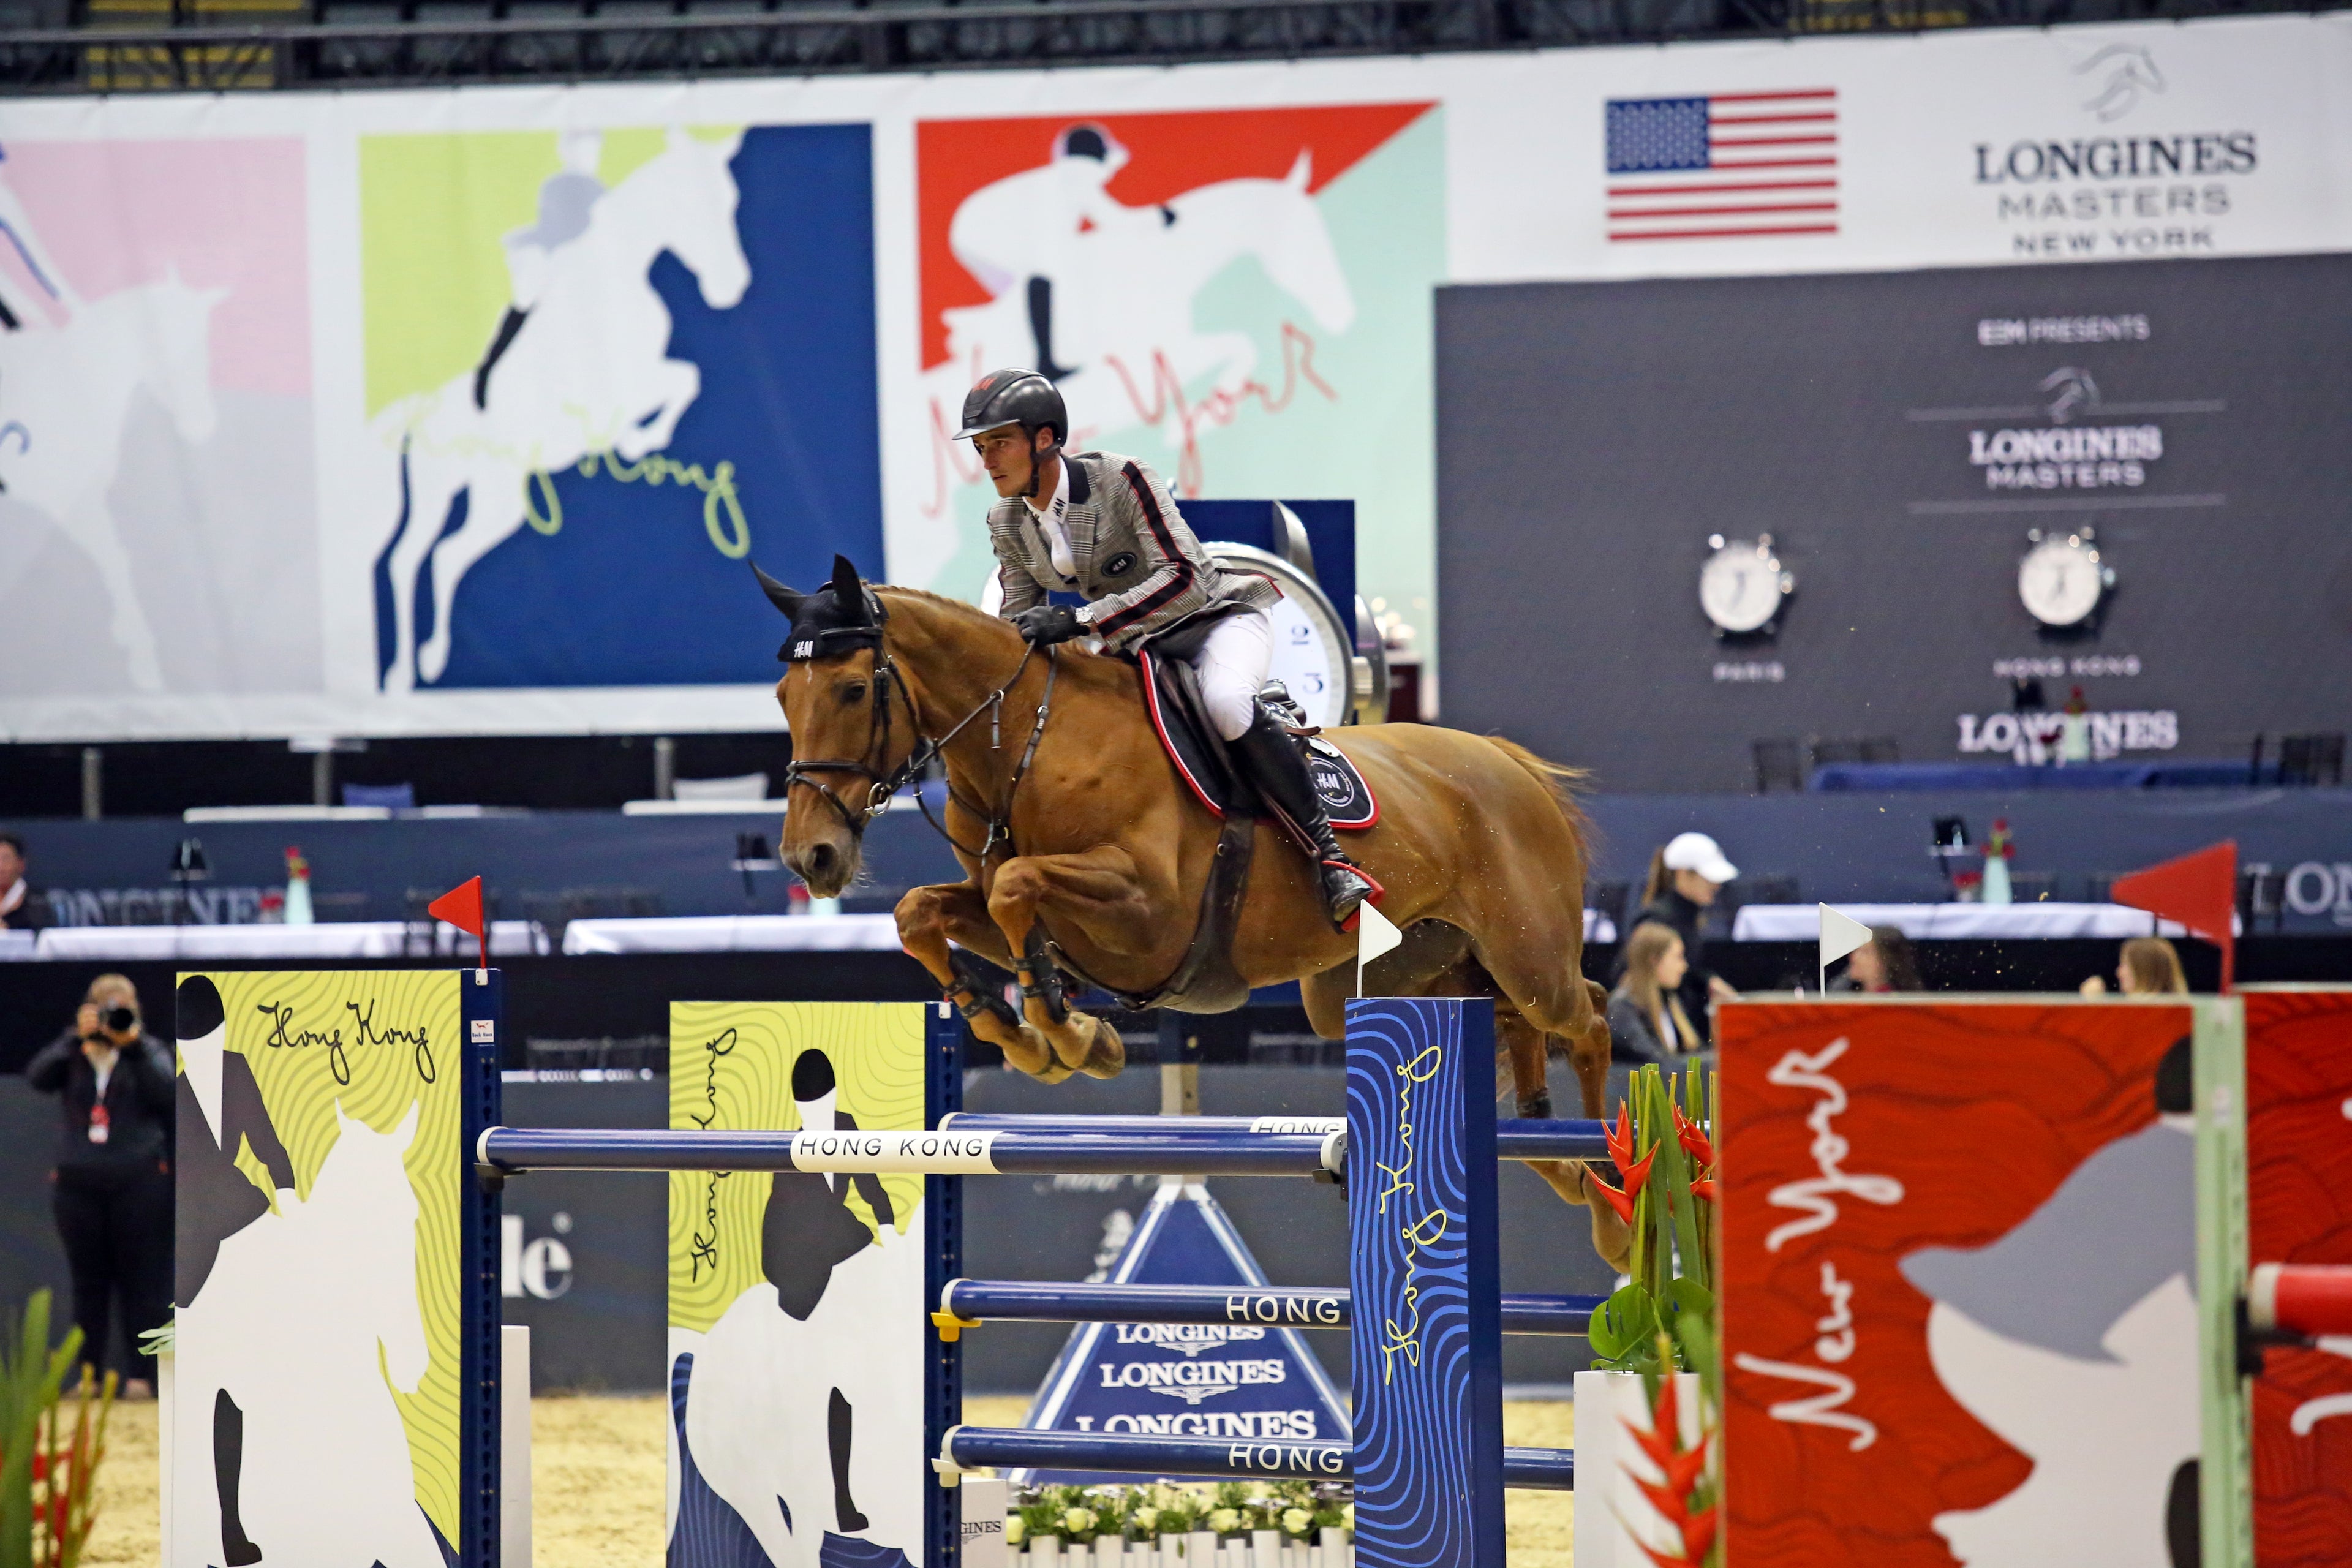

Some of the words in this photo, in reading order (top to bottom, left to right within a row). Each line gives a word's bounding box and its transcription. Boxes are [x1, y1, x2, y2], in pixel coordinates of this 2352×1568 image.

[1972, 131, 2258, 184] LONGINES
[1998, 185, 2231, 222] MASTERS
[2013, 232, 2097, 255] NEW
[2111, 227, 2214, 253] YORK
[1968, 425, 2163, 465] LONGINES
[1986, 461, 2145, 489] MASTERS
[257, 1001, 350, 1085] Hong
[347, 998, 435, 1084] Kong
[1376, 1045, 1442, 1214] Kong
[799, 1137, 882, 1156] HONG
[900, 1137, 983, 1157] KONG
[1226, 1295, 1340, 1324] HONG
[1382, 1208, 1447, 1386] Hong
[1116, 1324, 1265, 1344] LONGINES
[1100, 1359, 1286, 1387] LONGINES
[1735, 1262, 1878, 1452] New
[1229, 1442, 1343, 1474] HONG
